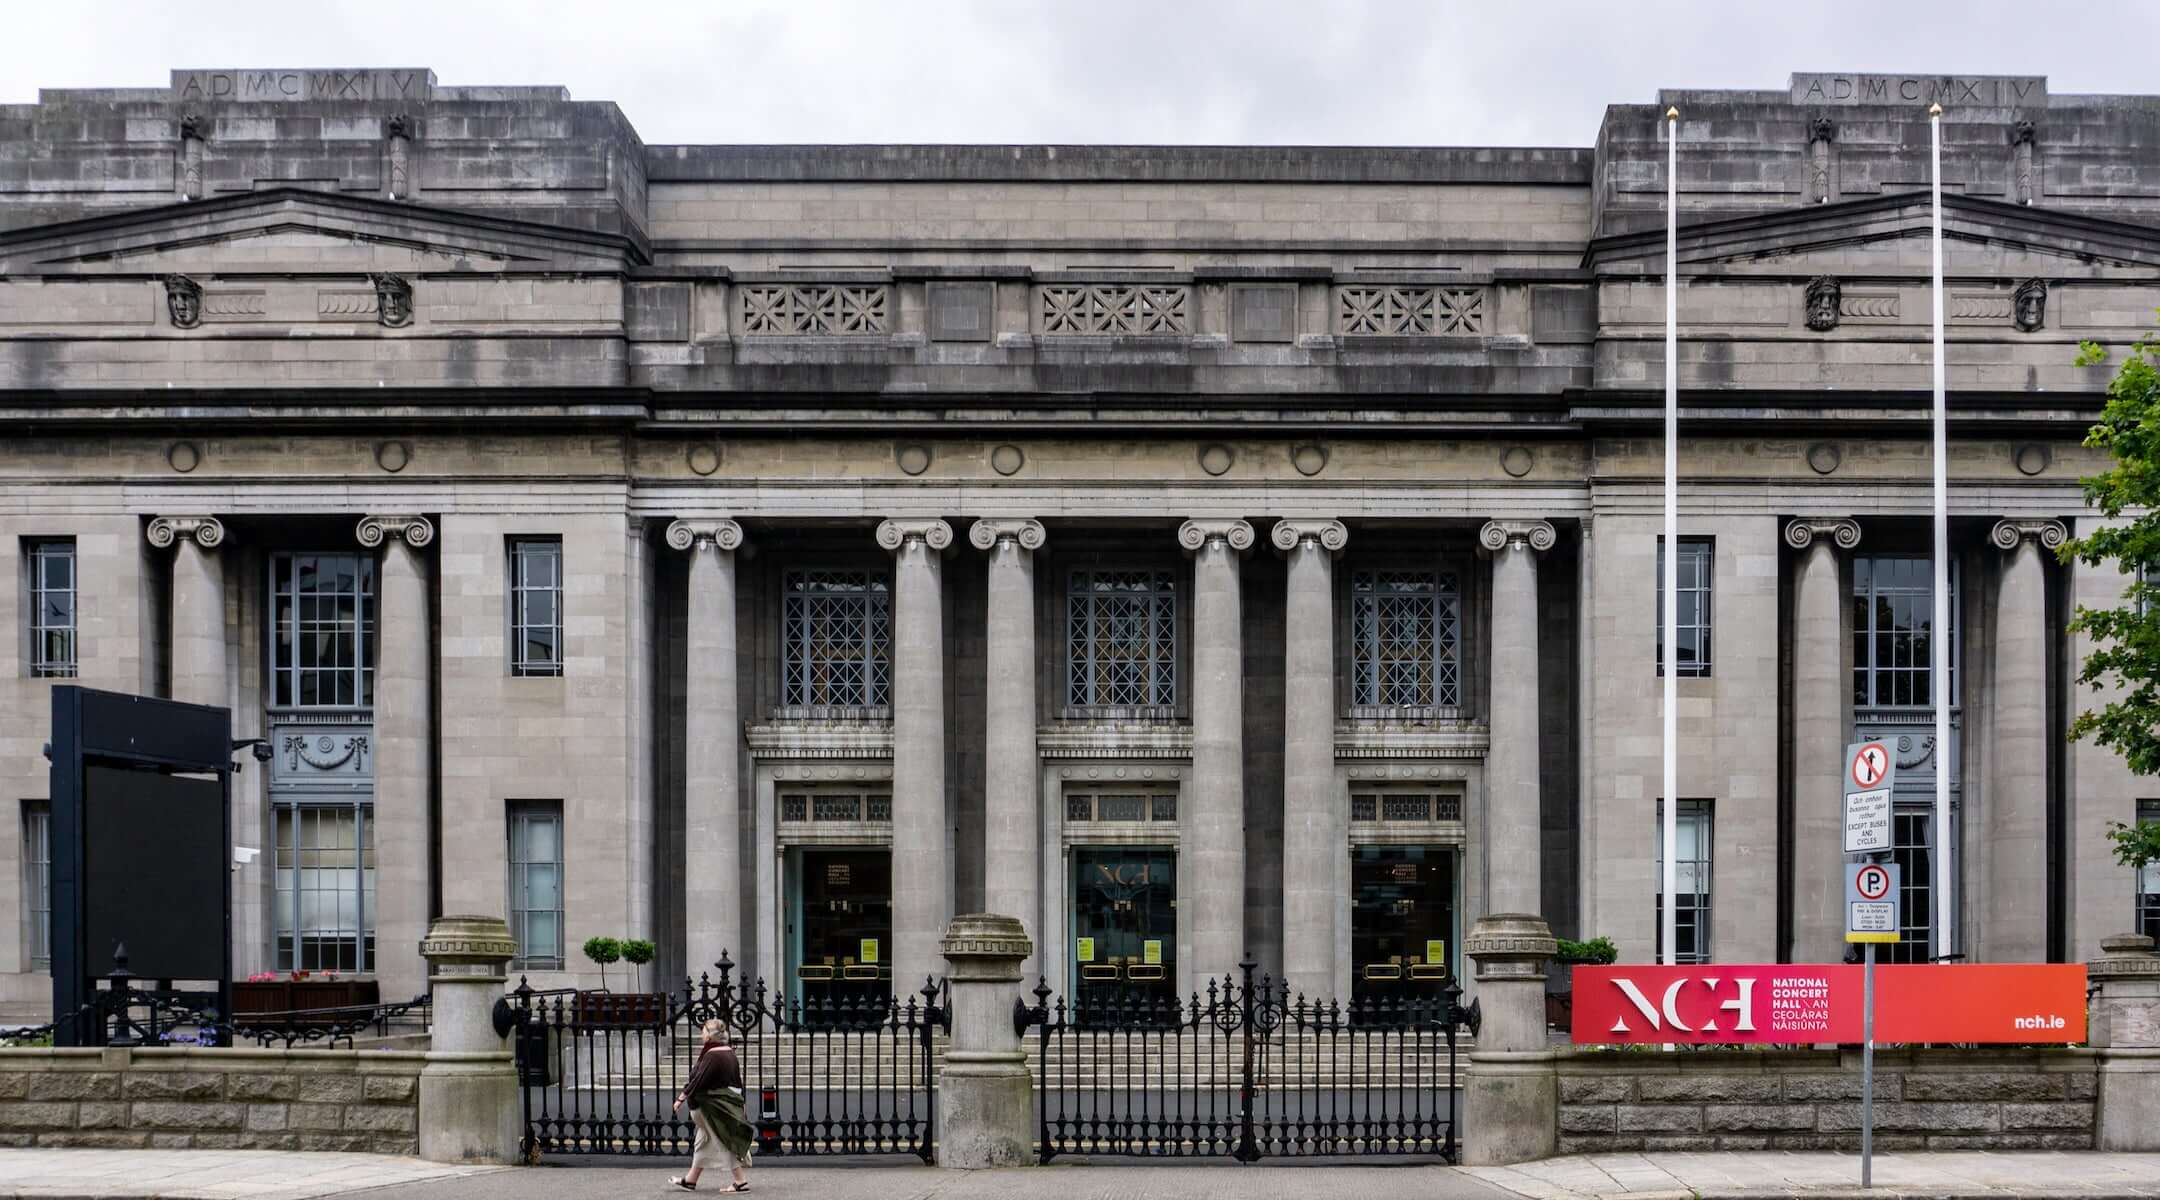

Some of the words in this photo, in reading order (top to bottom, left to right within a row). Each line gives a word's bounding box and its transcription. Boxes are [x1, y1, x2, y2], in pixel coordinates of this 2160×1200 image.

[1847, 821, 1868, 831] EXCEPT
[1869, 819, 1887, 829] BUSES
[1861, 829, 1873, 837] AND
[1856, 837, 1878, 846] CYCLES
[1772, 978, 1829, 988] NATIONAL
[1772, 989, 1829, 998] CONCERT
[1610, 978, 1757, 1032] NCH
[1772, 999, 1801, 1009] HALL
[1812, 999, 1829, 1009] AN
[1772, 1008, 1829, 1020] CEOLÁRAS
[1772, 1019, 1829, 1031] NÁISIÚNTA
[2015, 1014, 2065, 1029] nch.ie
